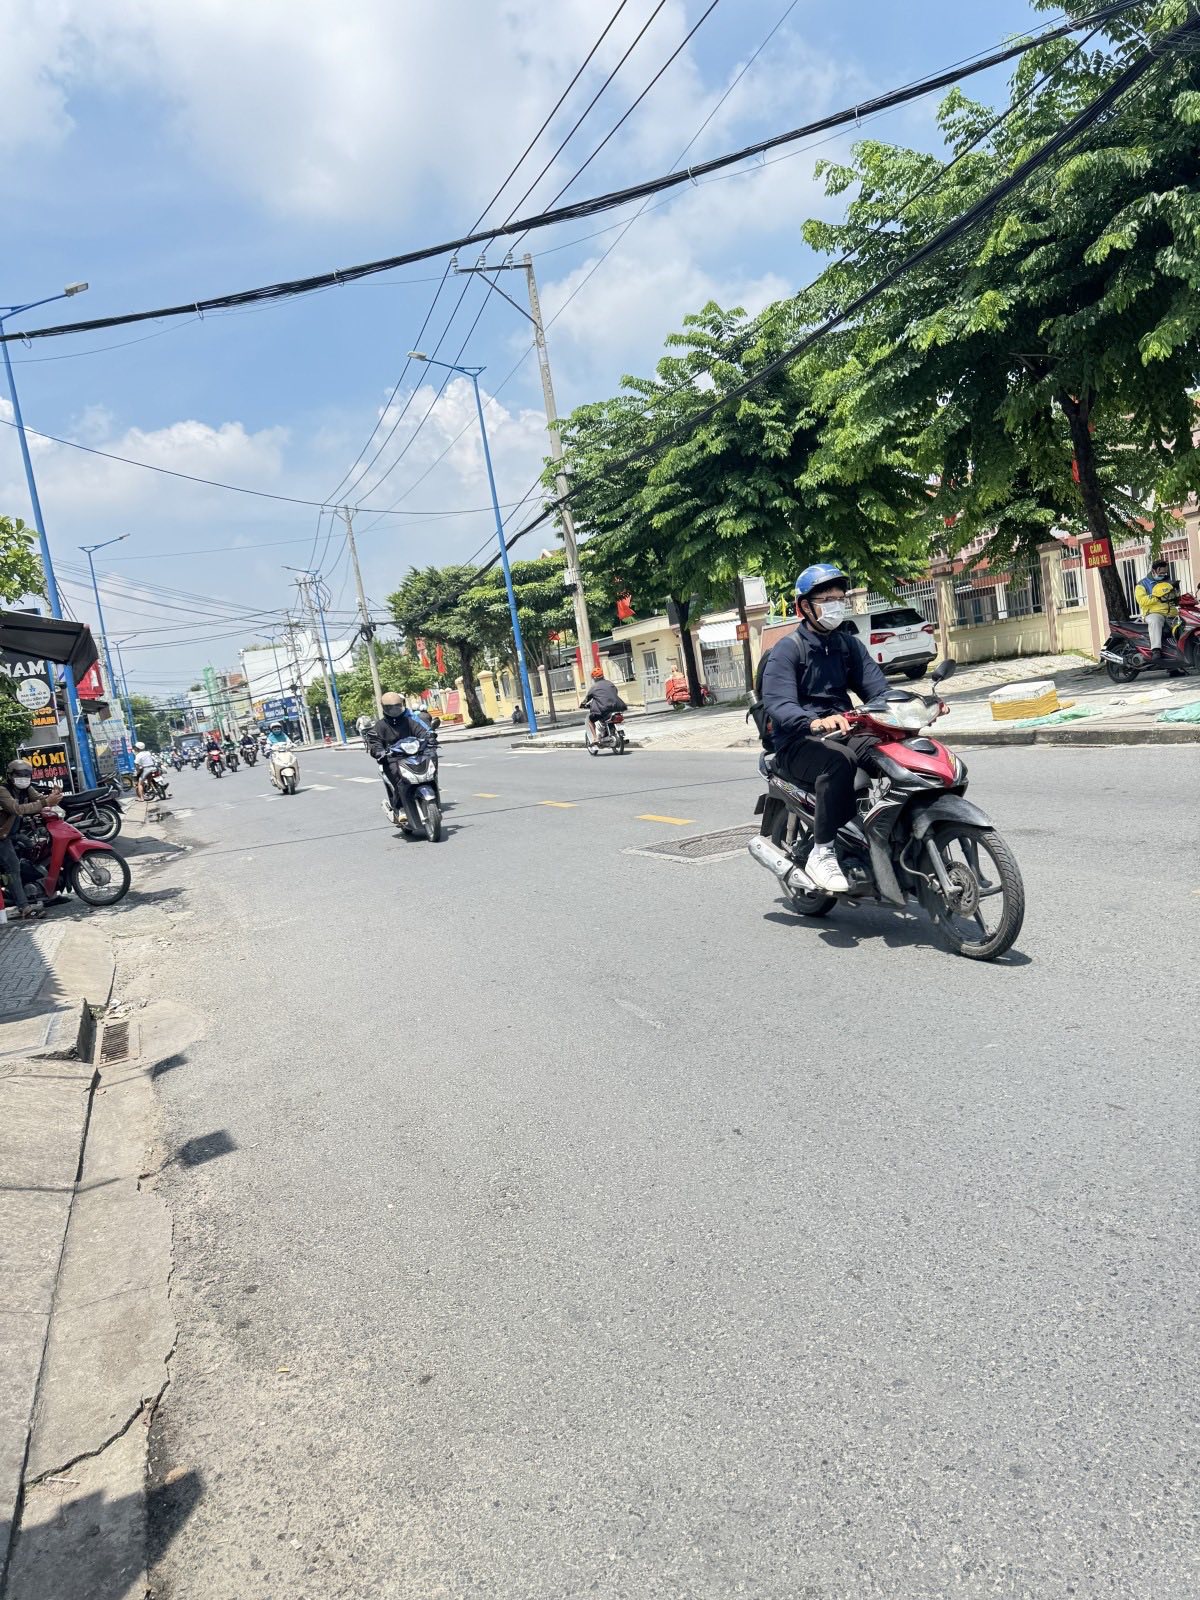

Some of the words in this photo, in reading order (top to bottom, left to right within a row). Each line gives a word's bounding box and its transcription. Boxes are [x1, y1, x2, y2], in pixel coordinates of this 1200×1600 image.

[1089, 541, 1103, 554] CẤM
[1100, 554, 1108, 564] XE
[49, 751, 66, 765] MI
